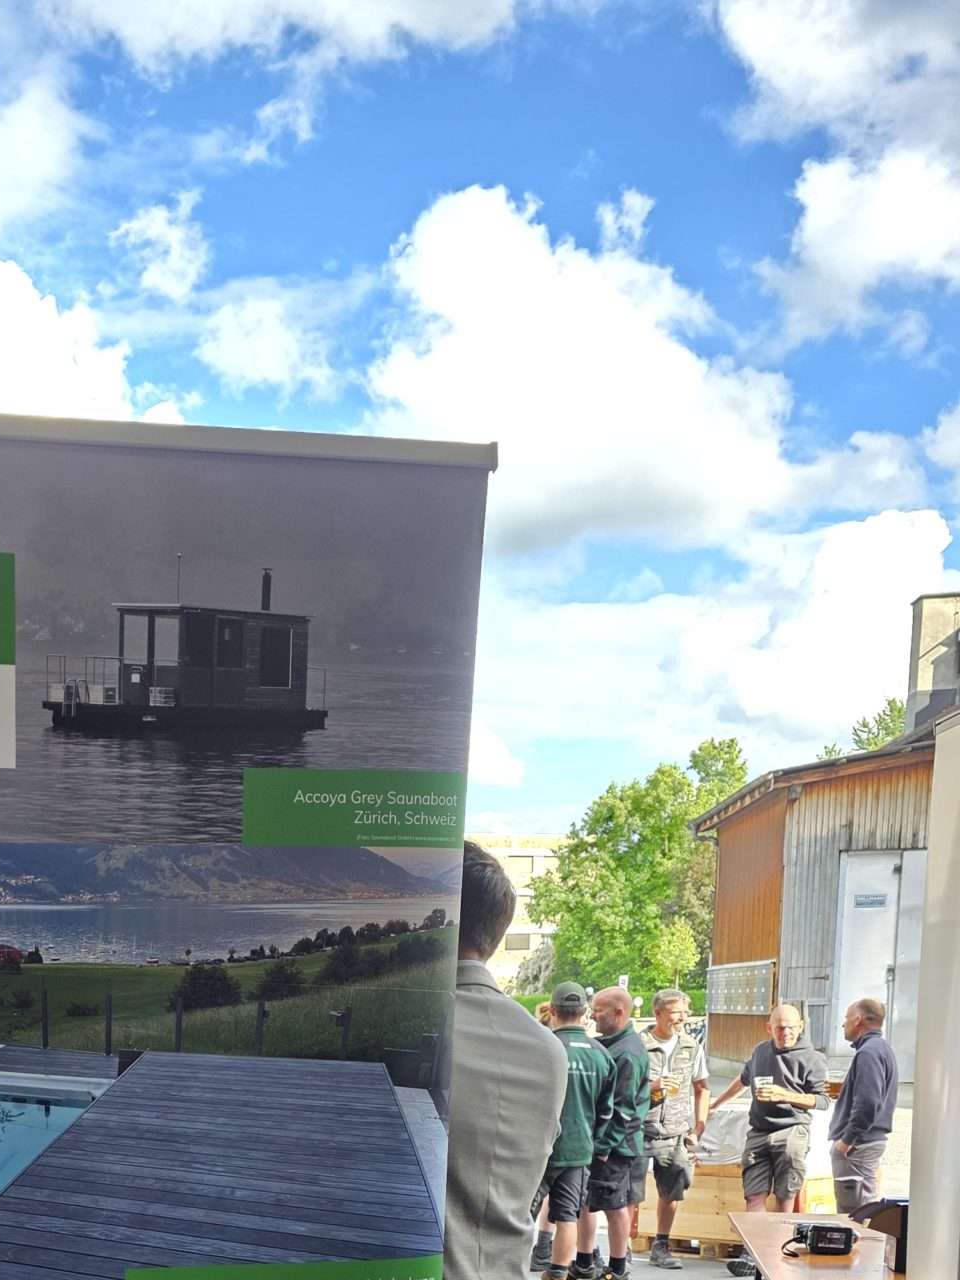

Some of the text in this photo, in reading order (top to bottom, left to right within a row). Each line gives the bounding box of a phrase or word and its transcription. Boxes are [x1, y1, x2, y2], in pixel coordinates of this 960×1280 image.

[293, 790, 457, 807] Accoya Grey Saunaboot
[354, 810, 457, 826] Zürich, Schweiz
